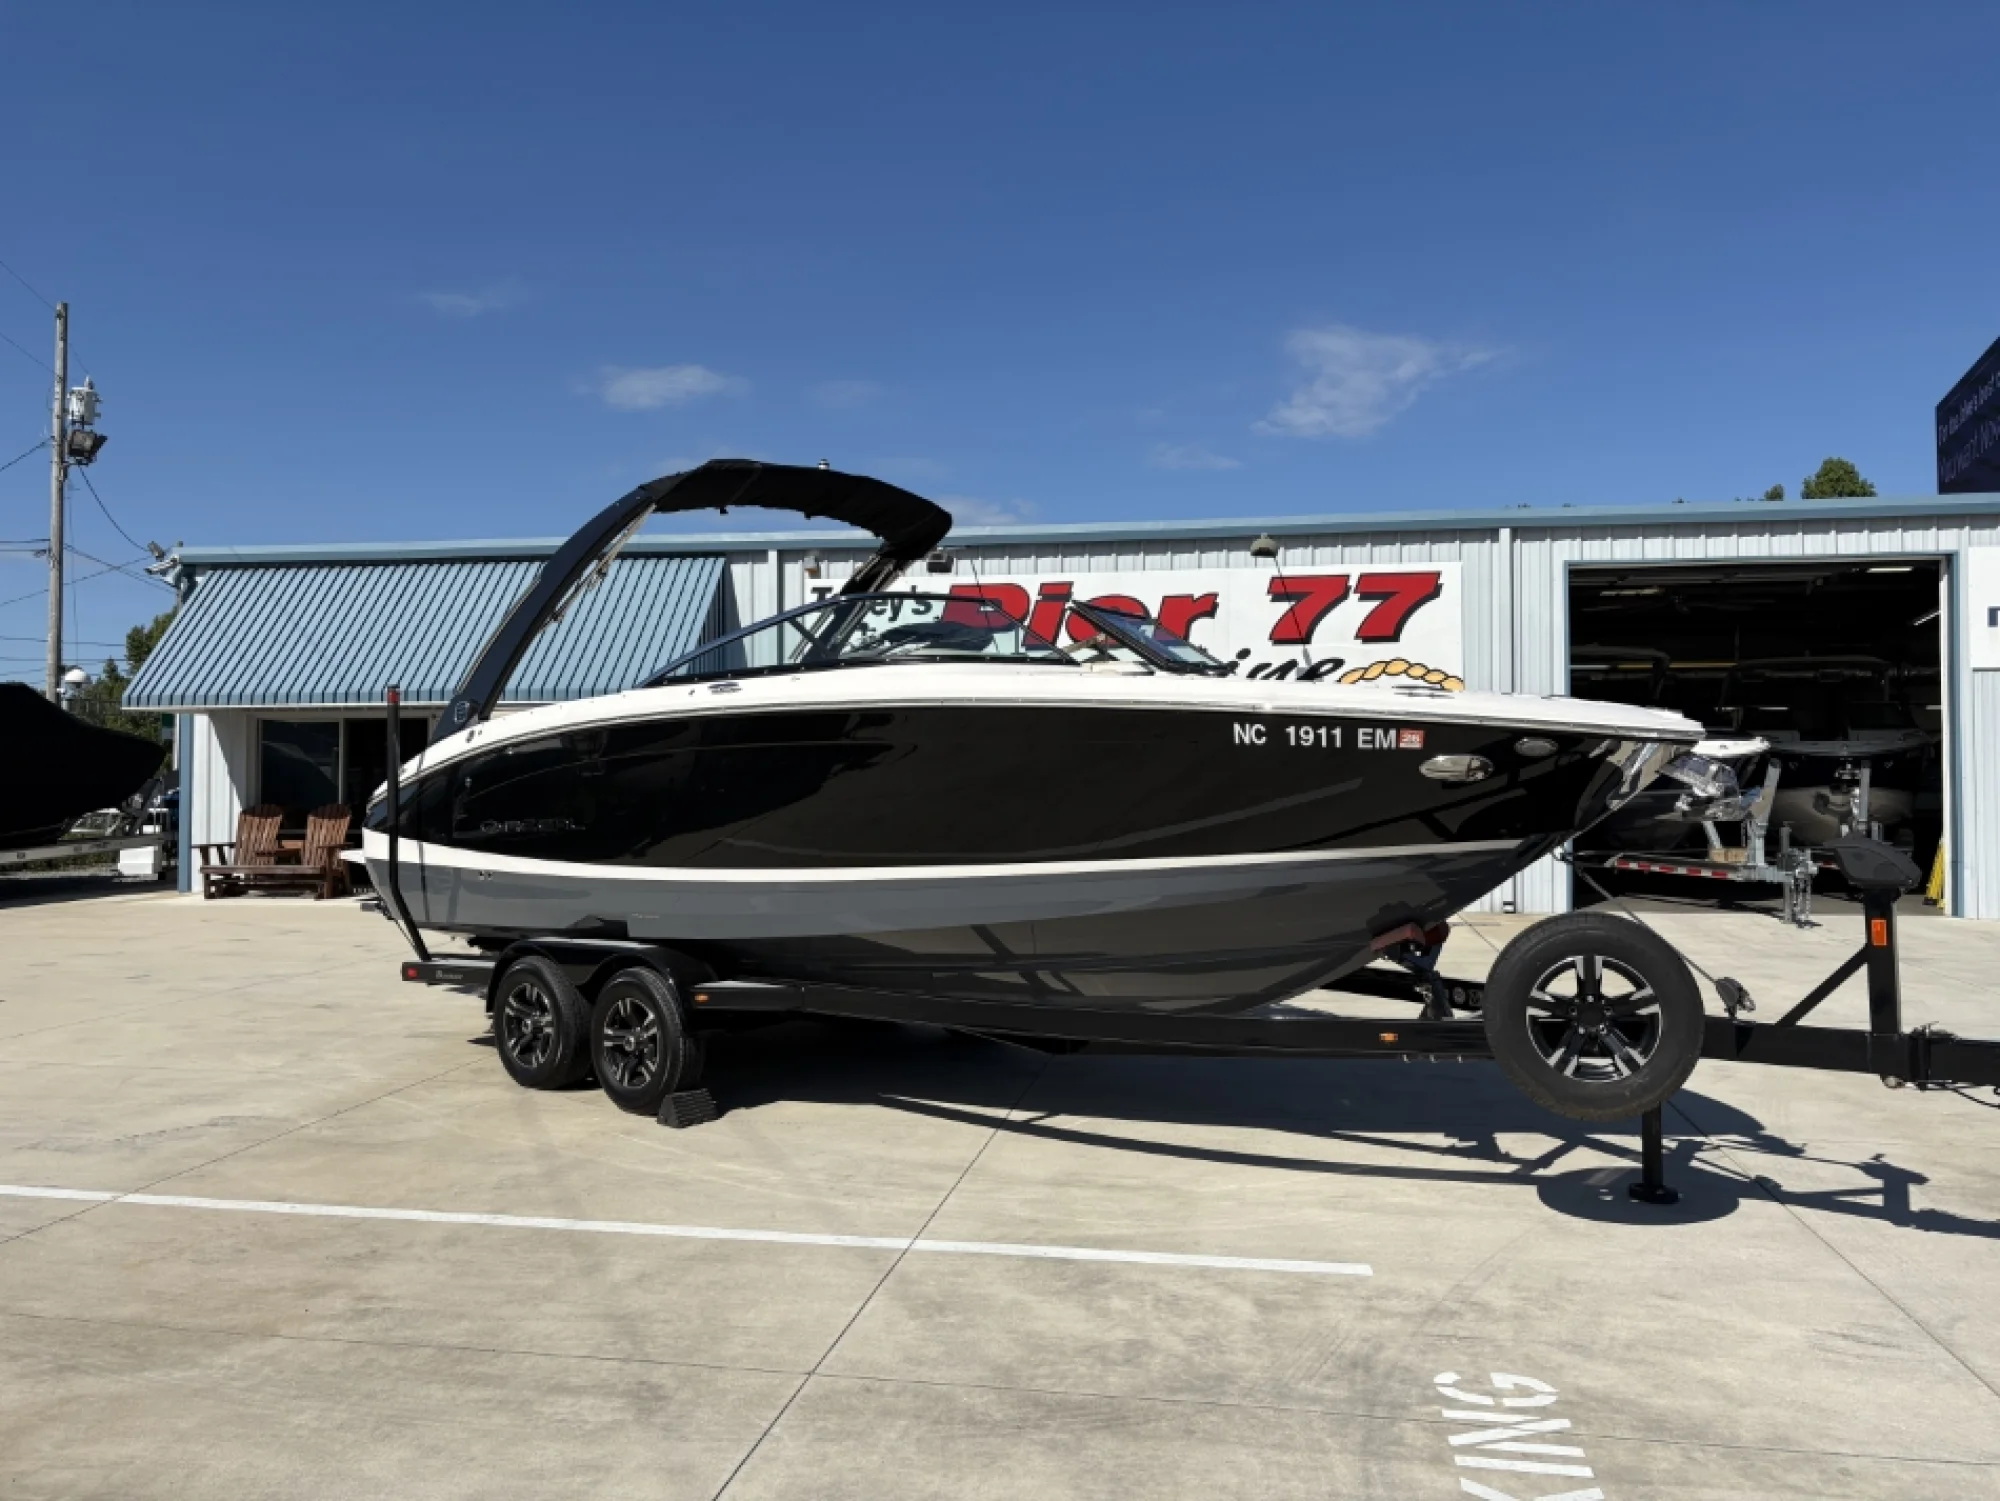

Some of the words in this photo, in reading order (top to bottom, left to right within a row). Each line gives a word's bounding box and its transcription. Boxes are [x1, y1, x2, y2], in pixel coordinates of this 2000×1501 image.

[939, 581, 1219, 648] Pier
[1266, 571, 1442, 644] 77
[1233, 722, 1267, 744] NC
[1286, 725, 1342, 748] 1911
[1357, 727, 1397, 749] EM
